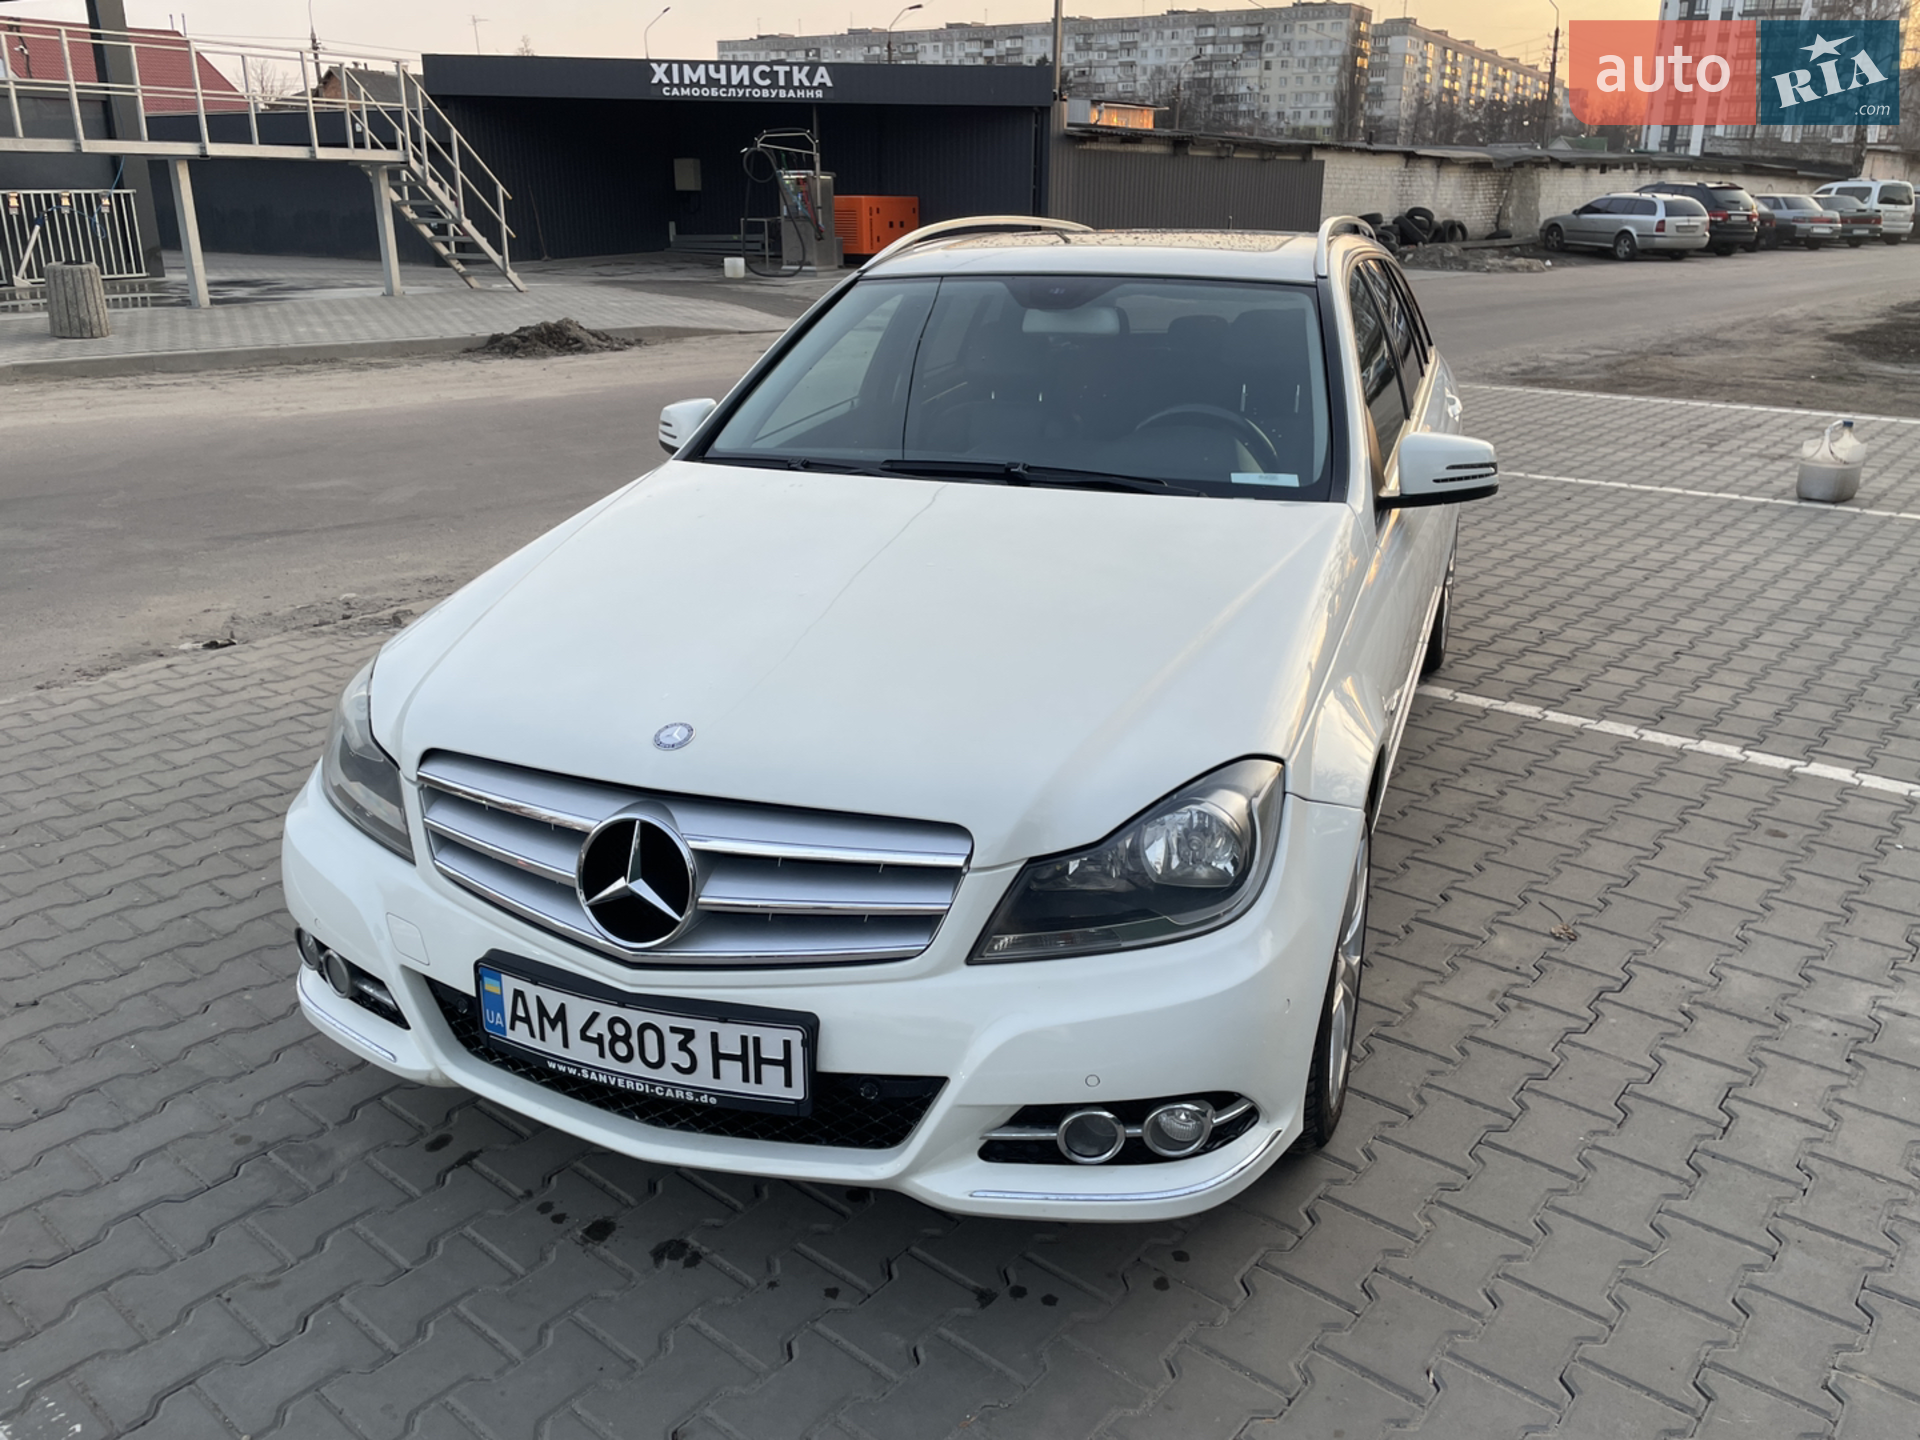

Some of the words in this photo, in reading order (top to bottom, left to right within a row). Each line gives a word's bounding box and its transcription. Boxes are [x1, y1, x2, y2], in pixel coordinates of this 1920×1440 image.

[650, 62, 833, 87] ХІМЧИСТКА
[662, 86, 823, 98] САМООБСЛУГОВУВАННЯ
[486, 1009, 504, 1028] UA
[509, 988, 570, 1050] AM
[579, 1011, 698, 1076] 4803
[710, 1031, 793, 1089] HH
[546, 1059, 718, 1106] www.SANVERDI-CARS.de
